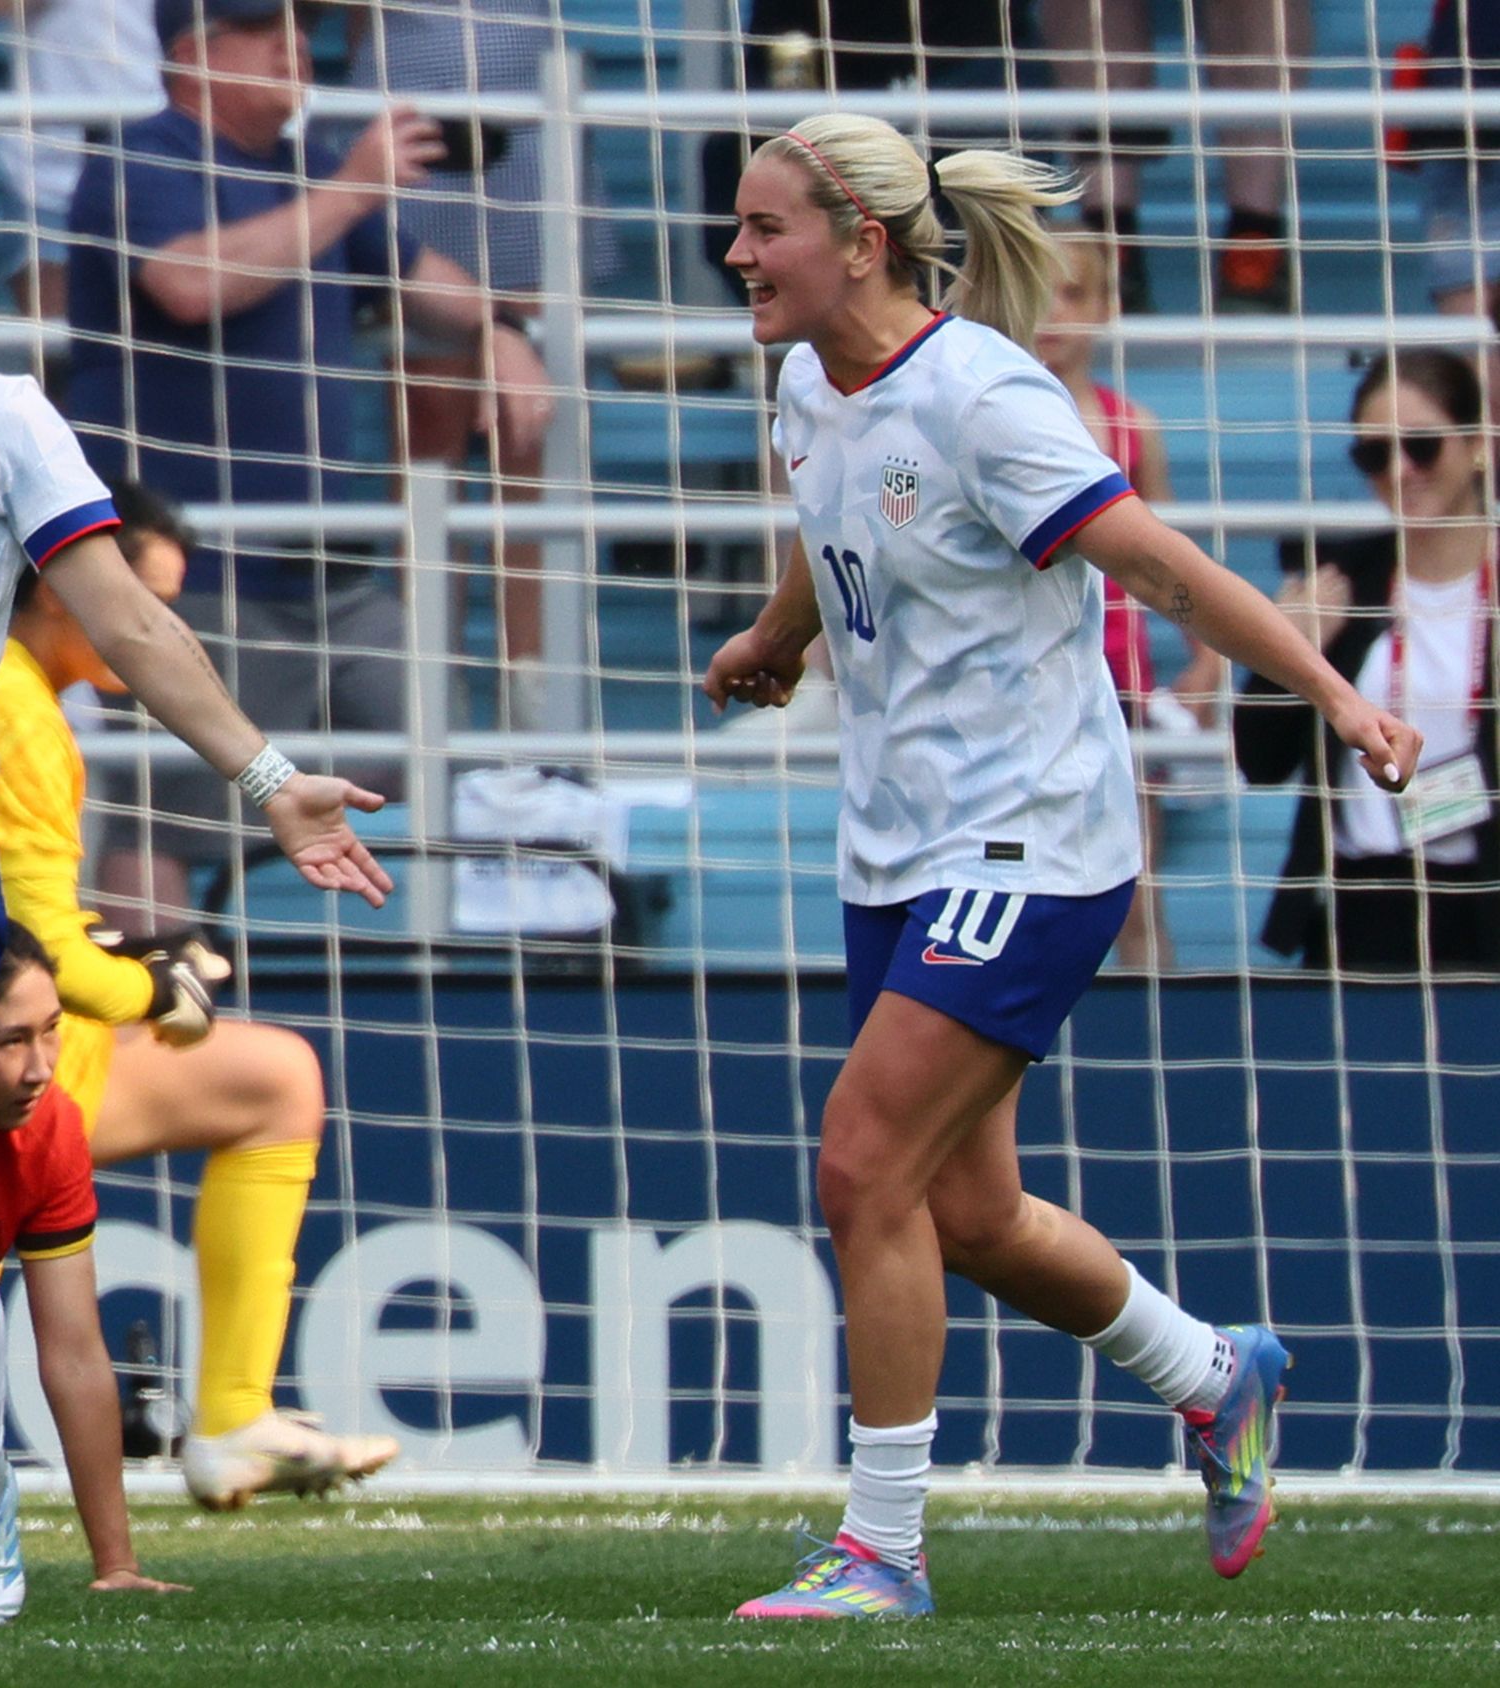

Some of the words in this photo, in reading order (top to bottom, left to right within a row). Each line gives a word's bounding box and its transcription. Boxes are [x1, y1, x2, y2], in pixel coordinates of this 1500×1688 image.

[884, 469, 916, 496] USA
[822, 544, 877, 643] 10
[927, 887, 1027, 961] 10
